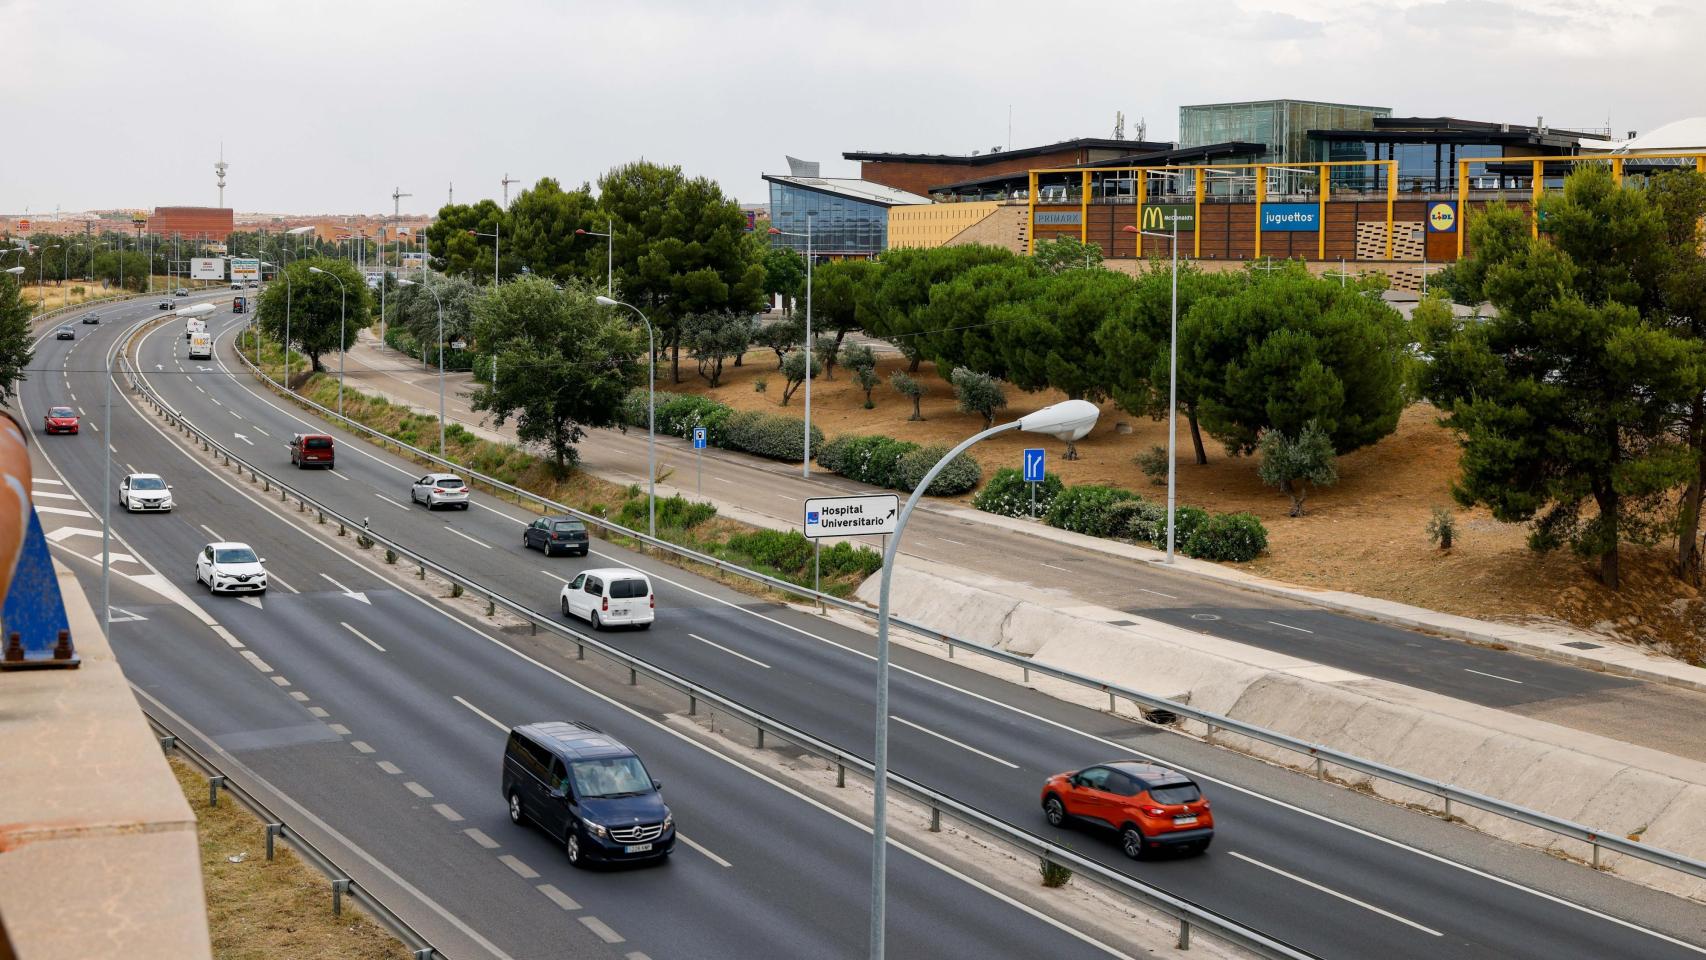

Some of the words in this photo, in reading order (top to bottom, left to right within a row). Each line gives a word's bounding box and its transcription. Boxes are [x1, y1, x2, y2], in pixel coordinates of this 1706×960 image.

[1038, 213, 1079, 223] PRIMARK
[1265, 211, 1313, 225] juguettos
[822, 504, 863, 516] Hospital
[821, 516, 884, 528] Universitario
